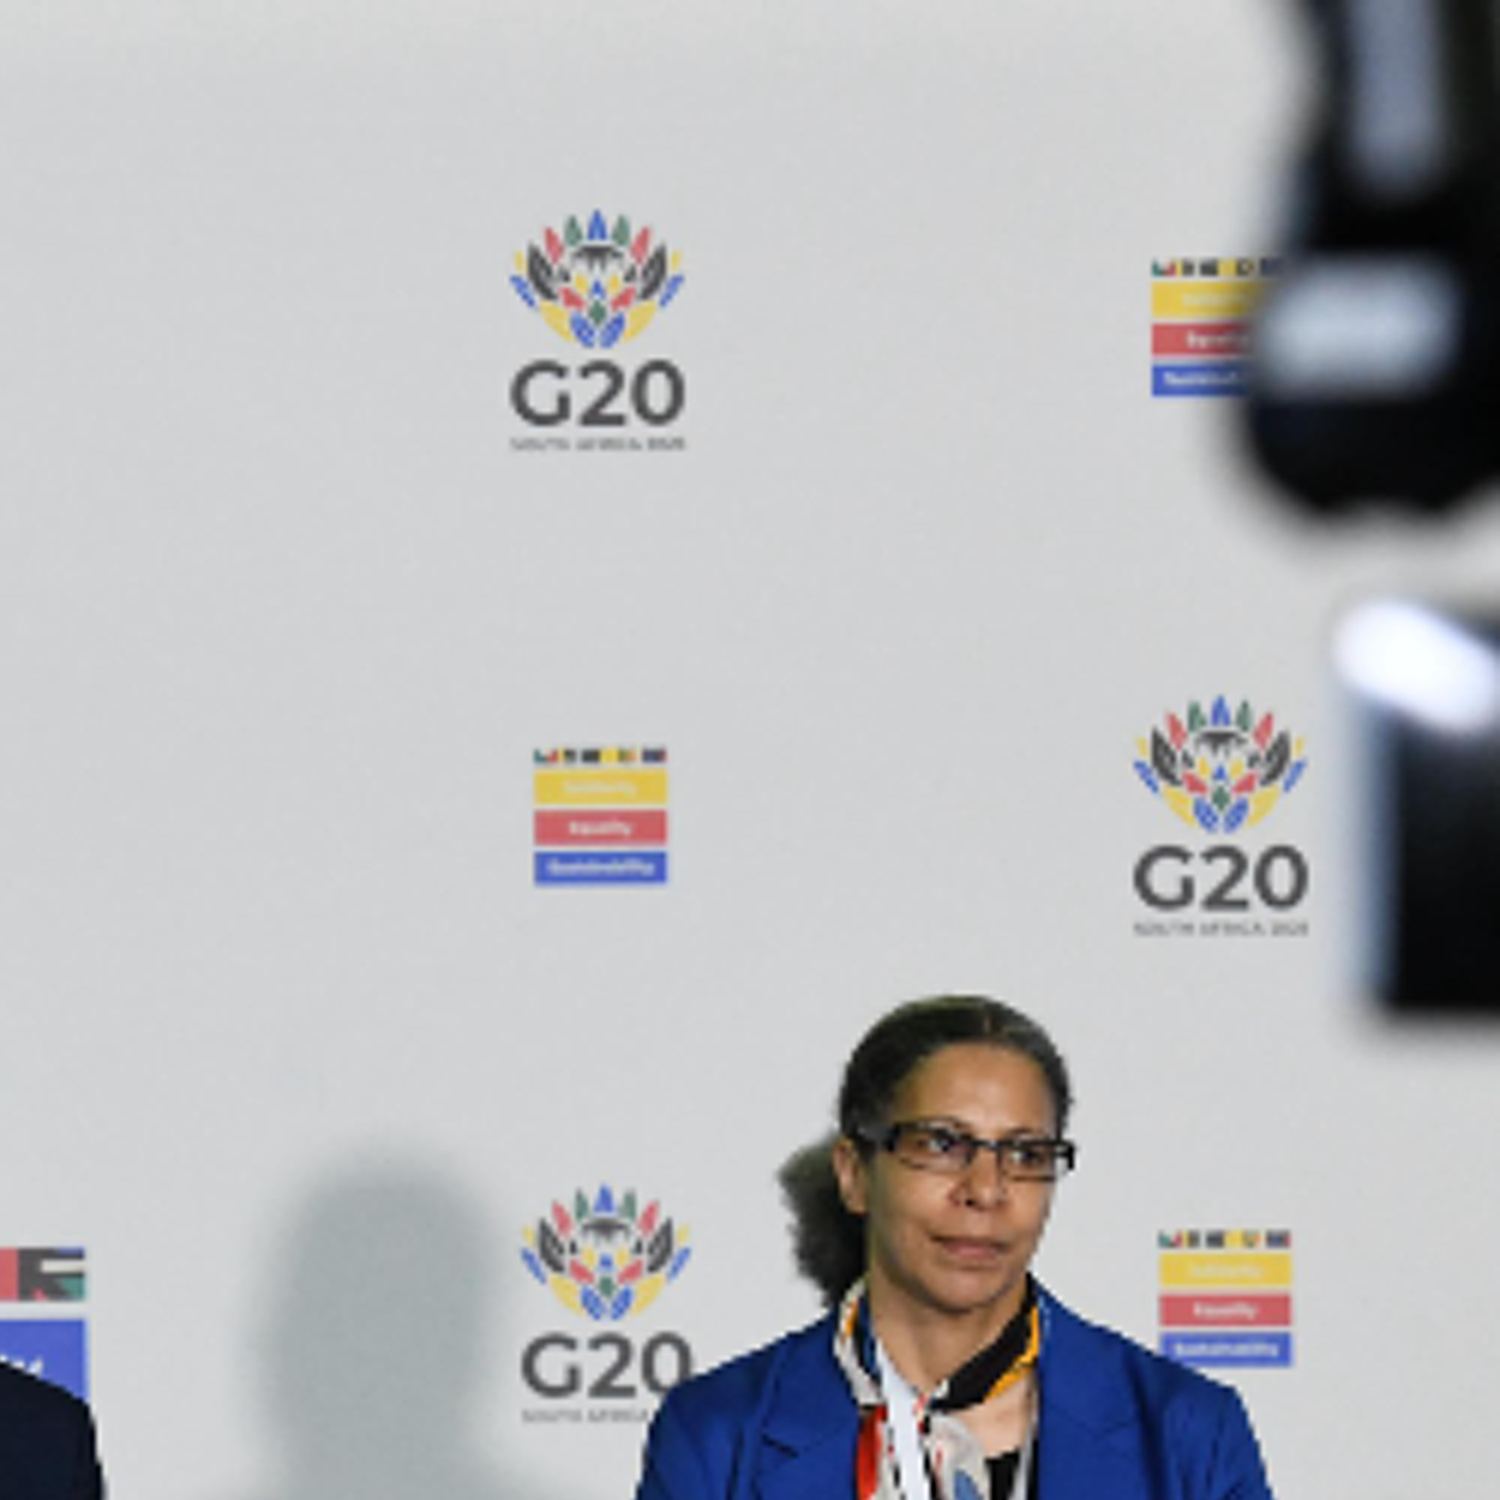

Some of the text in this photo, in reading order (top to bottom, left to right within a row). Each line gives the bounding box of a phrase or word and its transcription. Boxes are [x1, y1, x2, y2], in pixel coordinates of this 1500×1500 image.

[510, 358, 686, 427] G20
[1133, 844, 1310, 912] G20
[521, 1331, 693, 1398] G20
